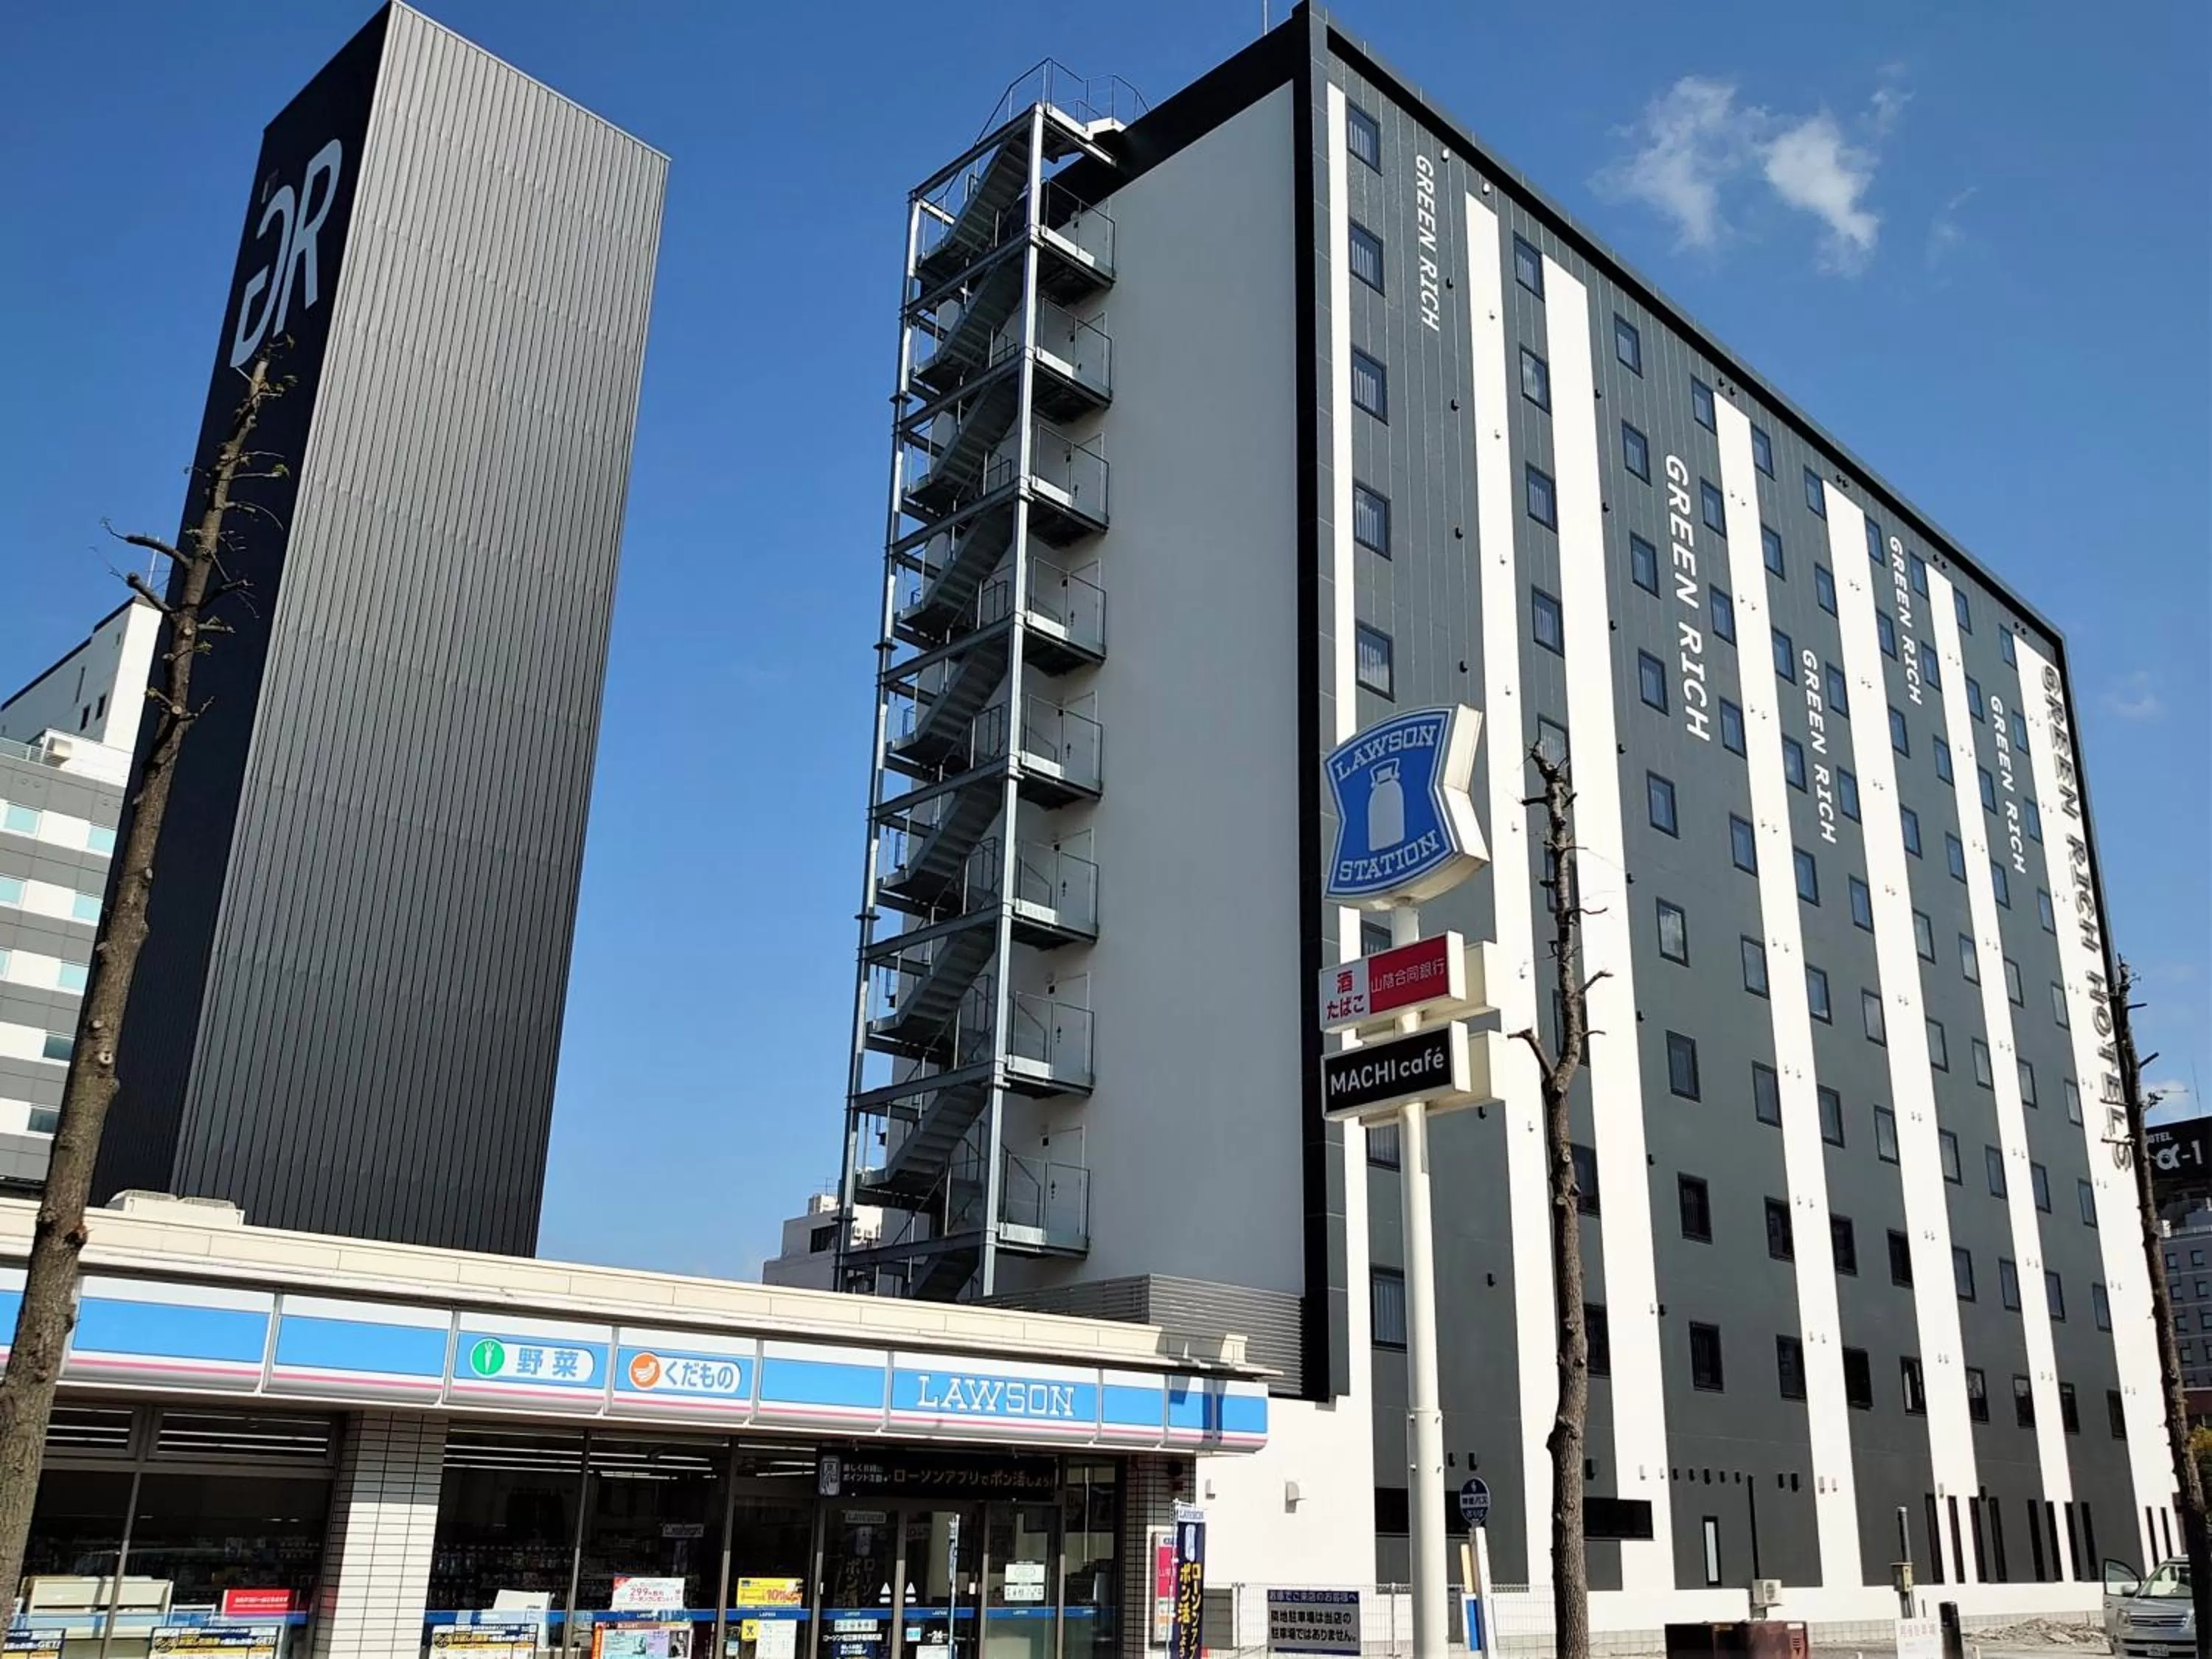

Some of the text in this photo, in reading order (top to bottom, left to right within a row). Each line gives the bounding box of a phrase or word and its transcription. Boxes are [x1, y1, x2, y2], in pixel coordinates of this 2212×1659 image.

[1415, 154, 1440, 332] GREEN RICH
[1666, 454, 1711, 741] GREEN RICH
[1889, 536, 1922, 705] GREEN RICH
[1335, 725, 1438, 782] LAWSON
[1802, 650, 1837, 844] GREEN RICH
[1991, 695, 2026, 874] GREEN RICH
[2041, 664, 2080, 821] GREEN
[2065, 832, 2100, 953] RICH
[1338, 830, 1441, 882] STATION
[1326, 995, 1364, 1020] たばこ
[1336, 970, 1354, 994] 酒
[1330, 1046, 1444, 1096] MACHI café
[2146, 1132, 2174, 1144] OTEL
[517, 1349, 579, 1378] 野菜
[665, 1361, 734, 1390] くだもの
[917, 1375, 1075, 1416] LAWSON
